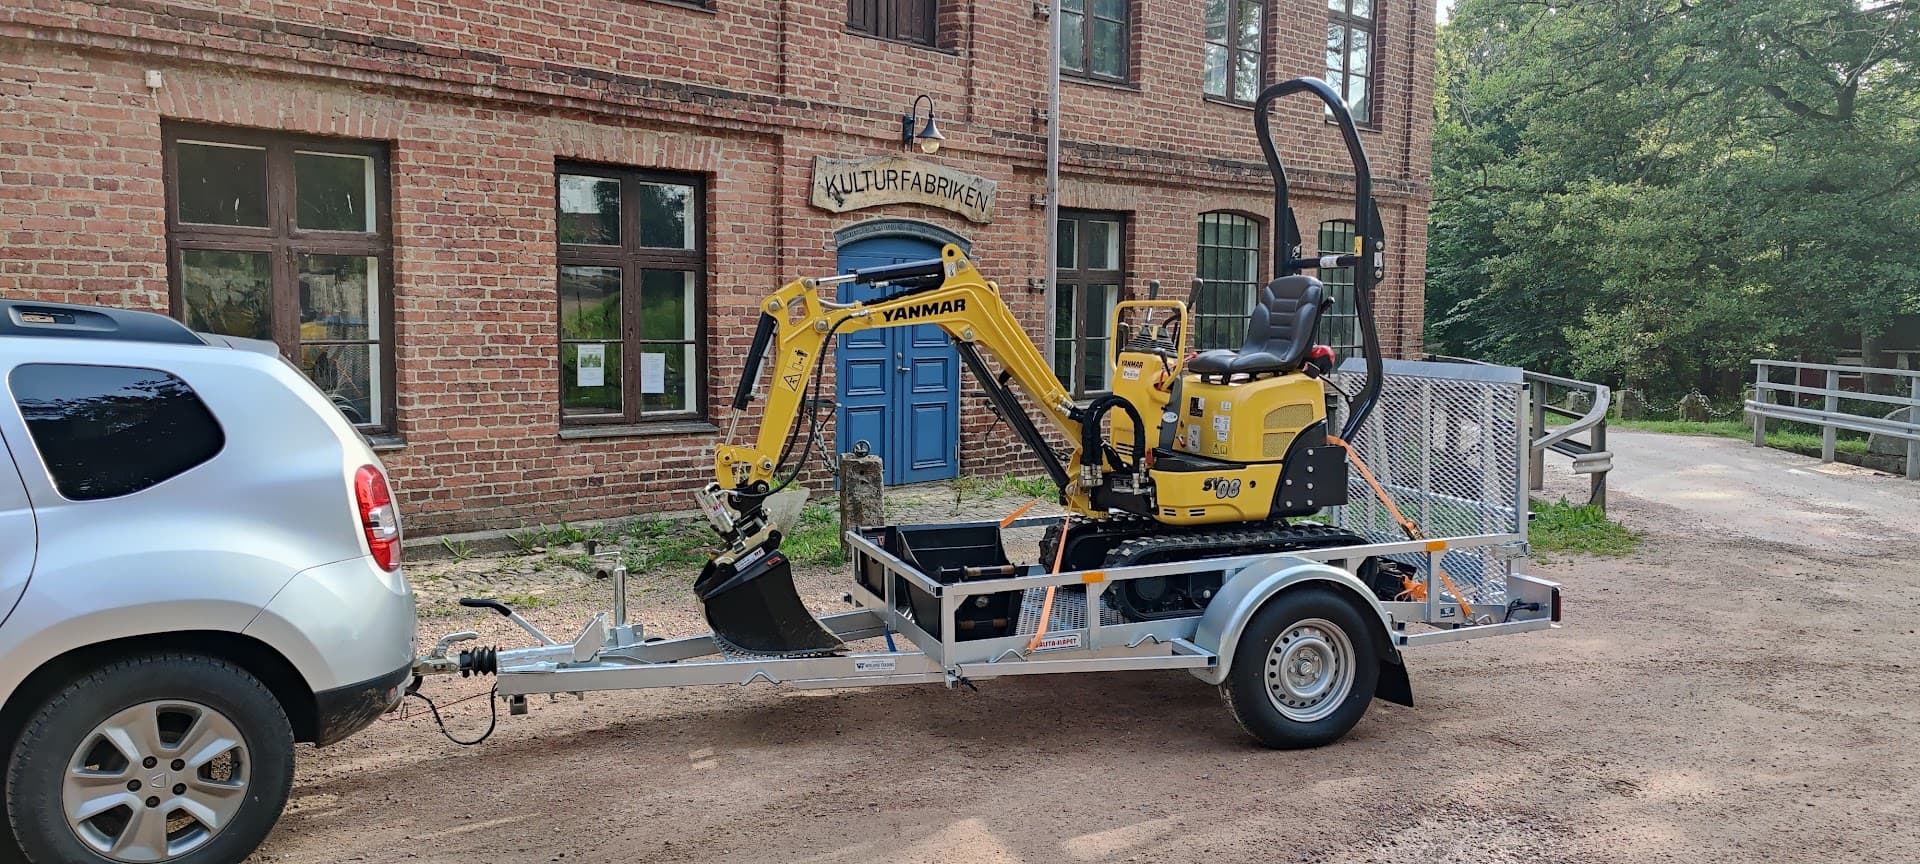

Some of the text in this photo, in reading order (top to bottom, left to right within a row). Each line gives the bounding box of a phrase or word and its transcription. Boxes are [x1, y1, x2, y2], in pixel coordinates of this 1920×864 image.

[825, 169, 988, 213] KULTURFABRIKEN
[882, 298, 966, 322] YANMAR
[1121, 360, 1144, 369] YANMAR
